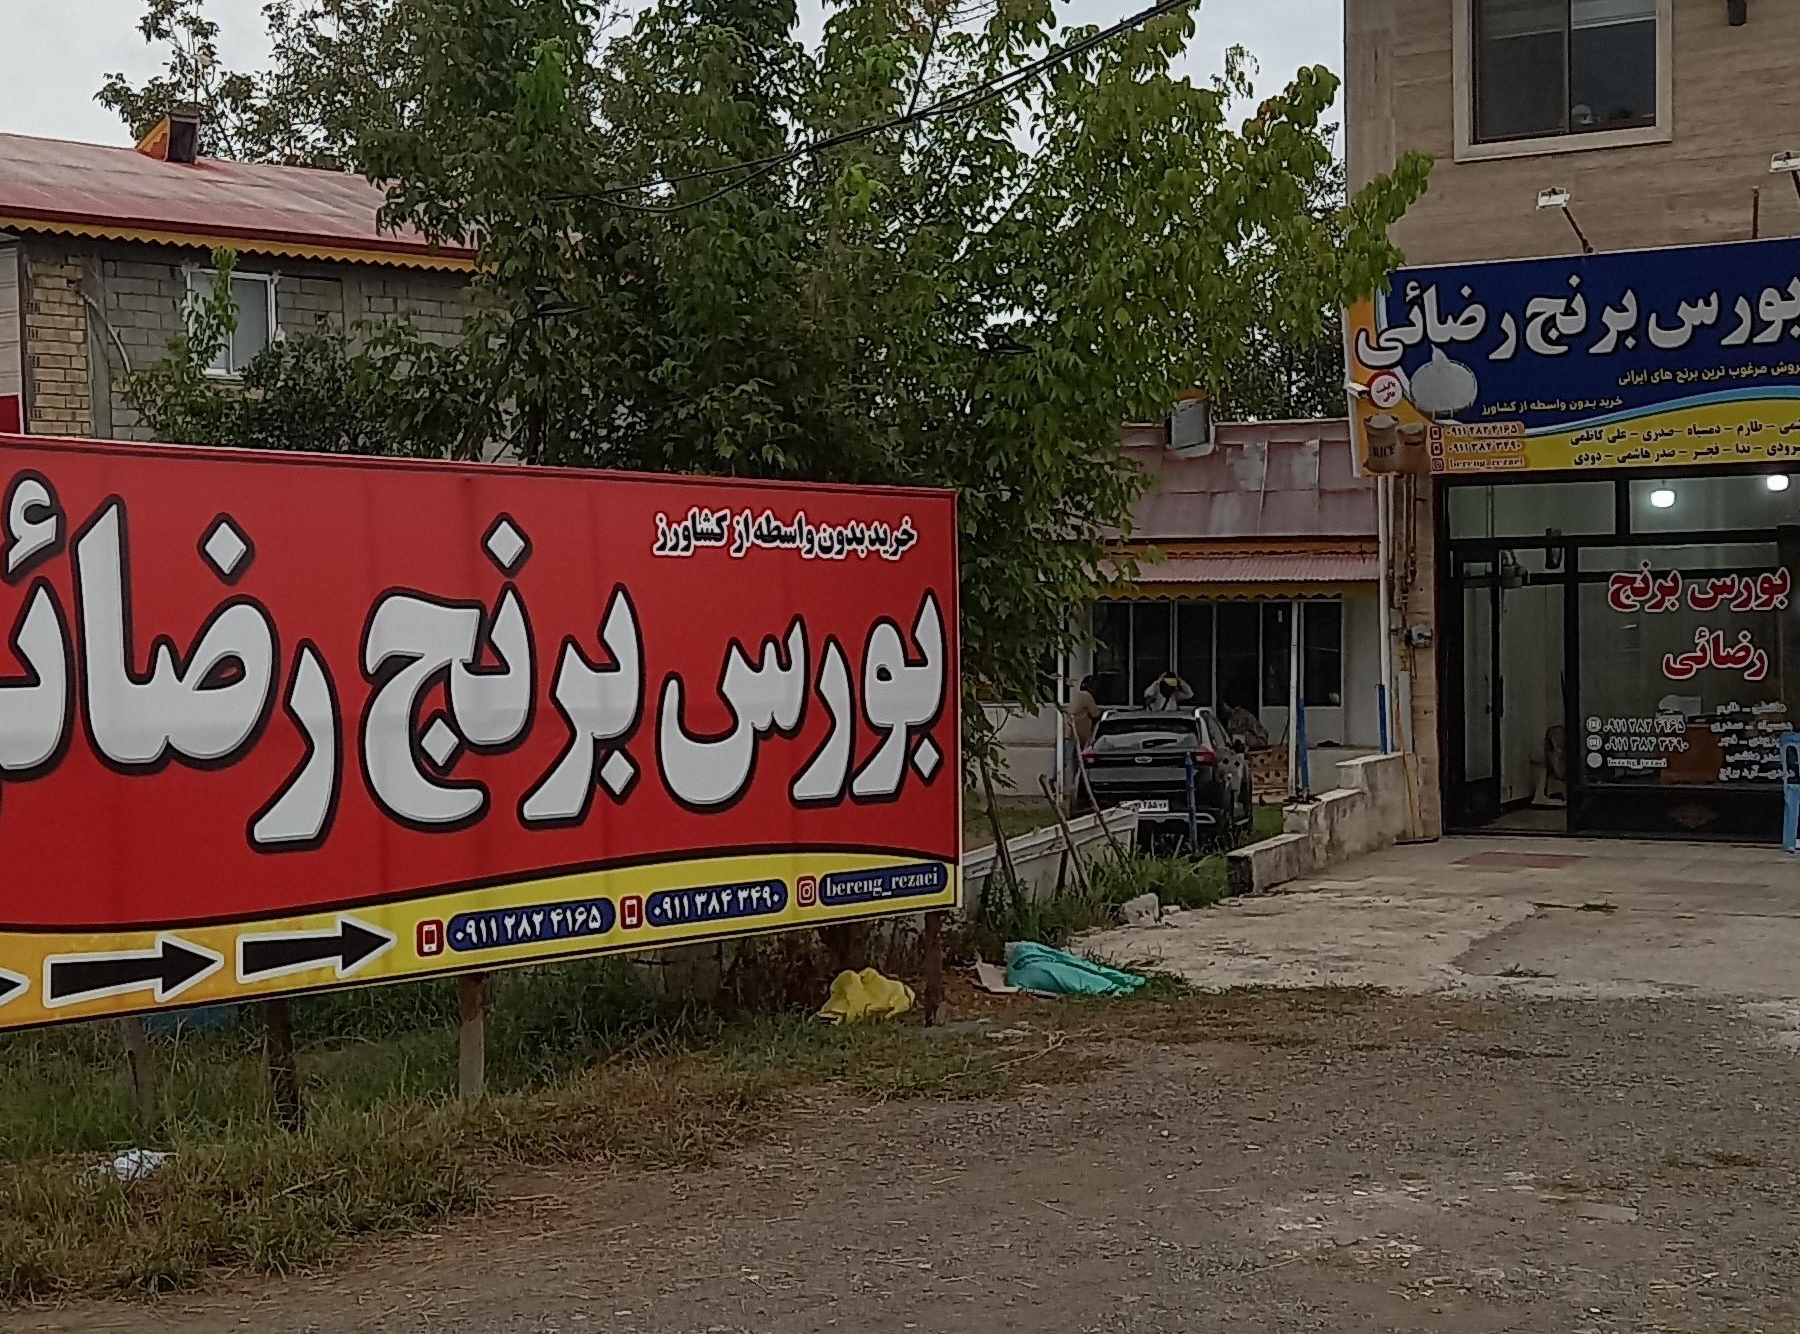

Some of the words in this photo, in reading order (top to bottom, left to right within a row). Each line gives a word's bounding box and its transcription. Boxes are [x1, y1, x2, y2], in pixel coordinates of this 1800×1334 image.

[1358, 280, 1518, 367] رضائی
[1525, 274, 1639, 356] برنج
[1648, 275, 1800, 348] بورس
[1618, 369, 1648, 386] ایرانی
[1650, 367, 1673, 384] های
[1676, 368, 1699, 384] برنج
[1701, 365, 1726, 381] ترین
[1729, 361, 1768, 379] مرغوب
[1770, 360, 1800, 377] روش
[1481, 400, 1517, 416] کشاورز
[1519, 400, 1528, 414] از
[1529, 398, 1567, 412] واسطه
[1568, 399, 1597, 411] بدون
[1599, 395, 1624, 409] خرید
[1570, 428, 1604, 446] کاظمی
[1607, 427, 1627, 444] علی
[1737, 420, 1763, 437] طارم
[1573, 451, 1602, 466] دودی
[1616, 447, 1651, 464] هاشمی
[1692, 442, 1720, 460] فجر
[653, 506, 730, 557] کشاورز
[730, 508, 752, 557] از
[752, 510, 816, 559] واسطه
[817, 518, 867, 559] بدون
[866, 515, 918, 560] خرید
[1607, 559, 1683, 613] برنج
[1687, 566, 1791, 612] بورس
[0, 475, 338, 847] رضائ
[1662, 626, 1769, 680] رضائی
[363, 517, 643, 827] برنج
[658, 591, 948, 807] بورس
[824, 866, 940, 898] bereng_rezaei
[653, 896, 691, 920] ۰۹۱۱
[694, 888, 735, 916] ۳۸۴
[737, 883, 781, 910] ۳۴۹۰
[455, 917, 499, 945] ۰۹۱۱
[503, 910, 545, 941] ۲۸۲
[549, 904, 602, 934] ۴۱۶۵
